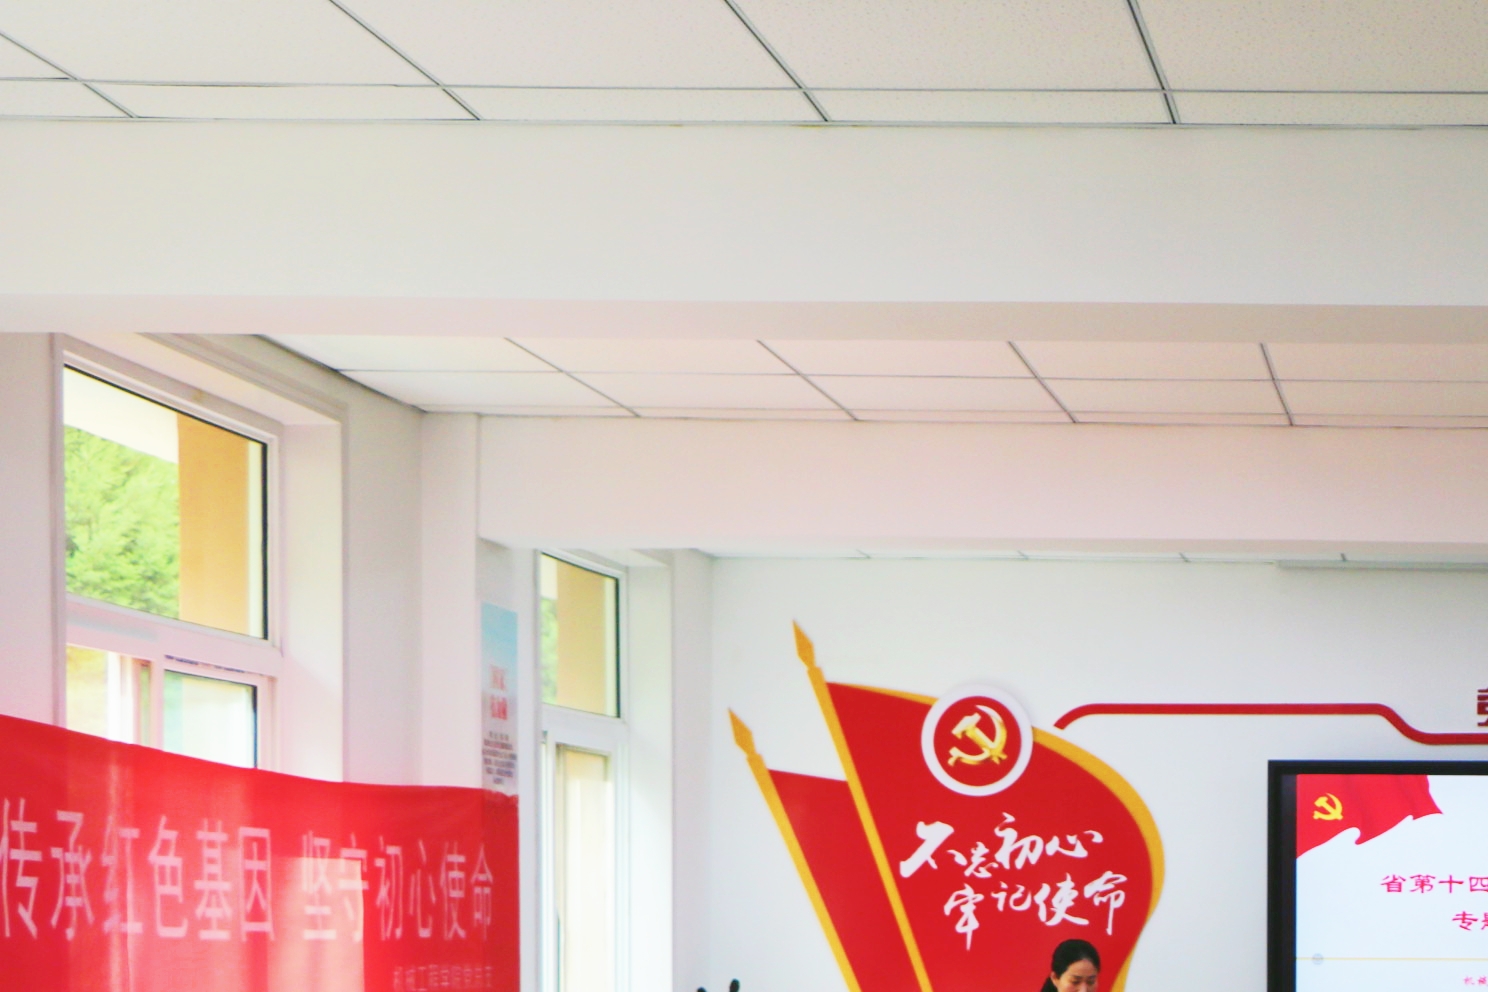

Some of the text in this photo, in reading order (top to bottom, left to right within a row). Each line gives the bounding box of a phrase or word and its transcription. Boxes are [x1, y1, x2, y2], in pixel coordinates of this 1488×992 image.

[0, 797, 494, 943] 传承红色基因 坚守初心使命
[900, 812, 1104, 878] 不忘初心
[943, 870, 1128, 951] 牢记使命
